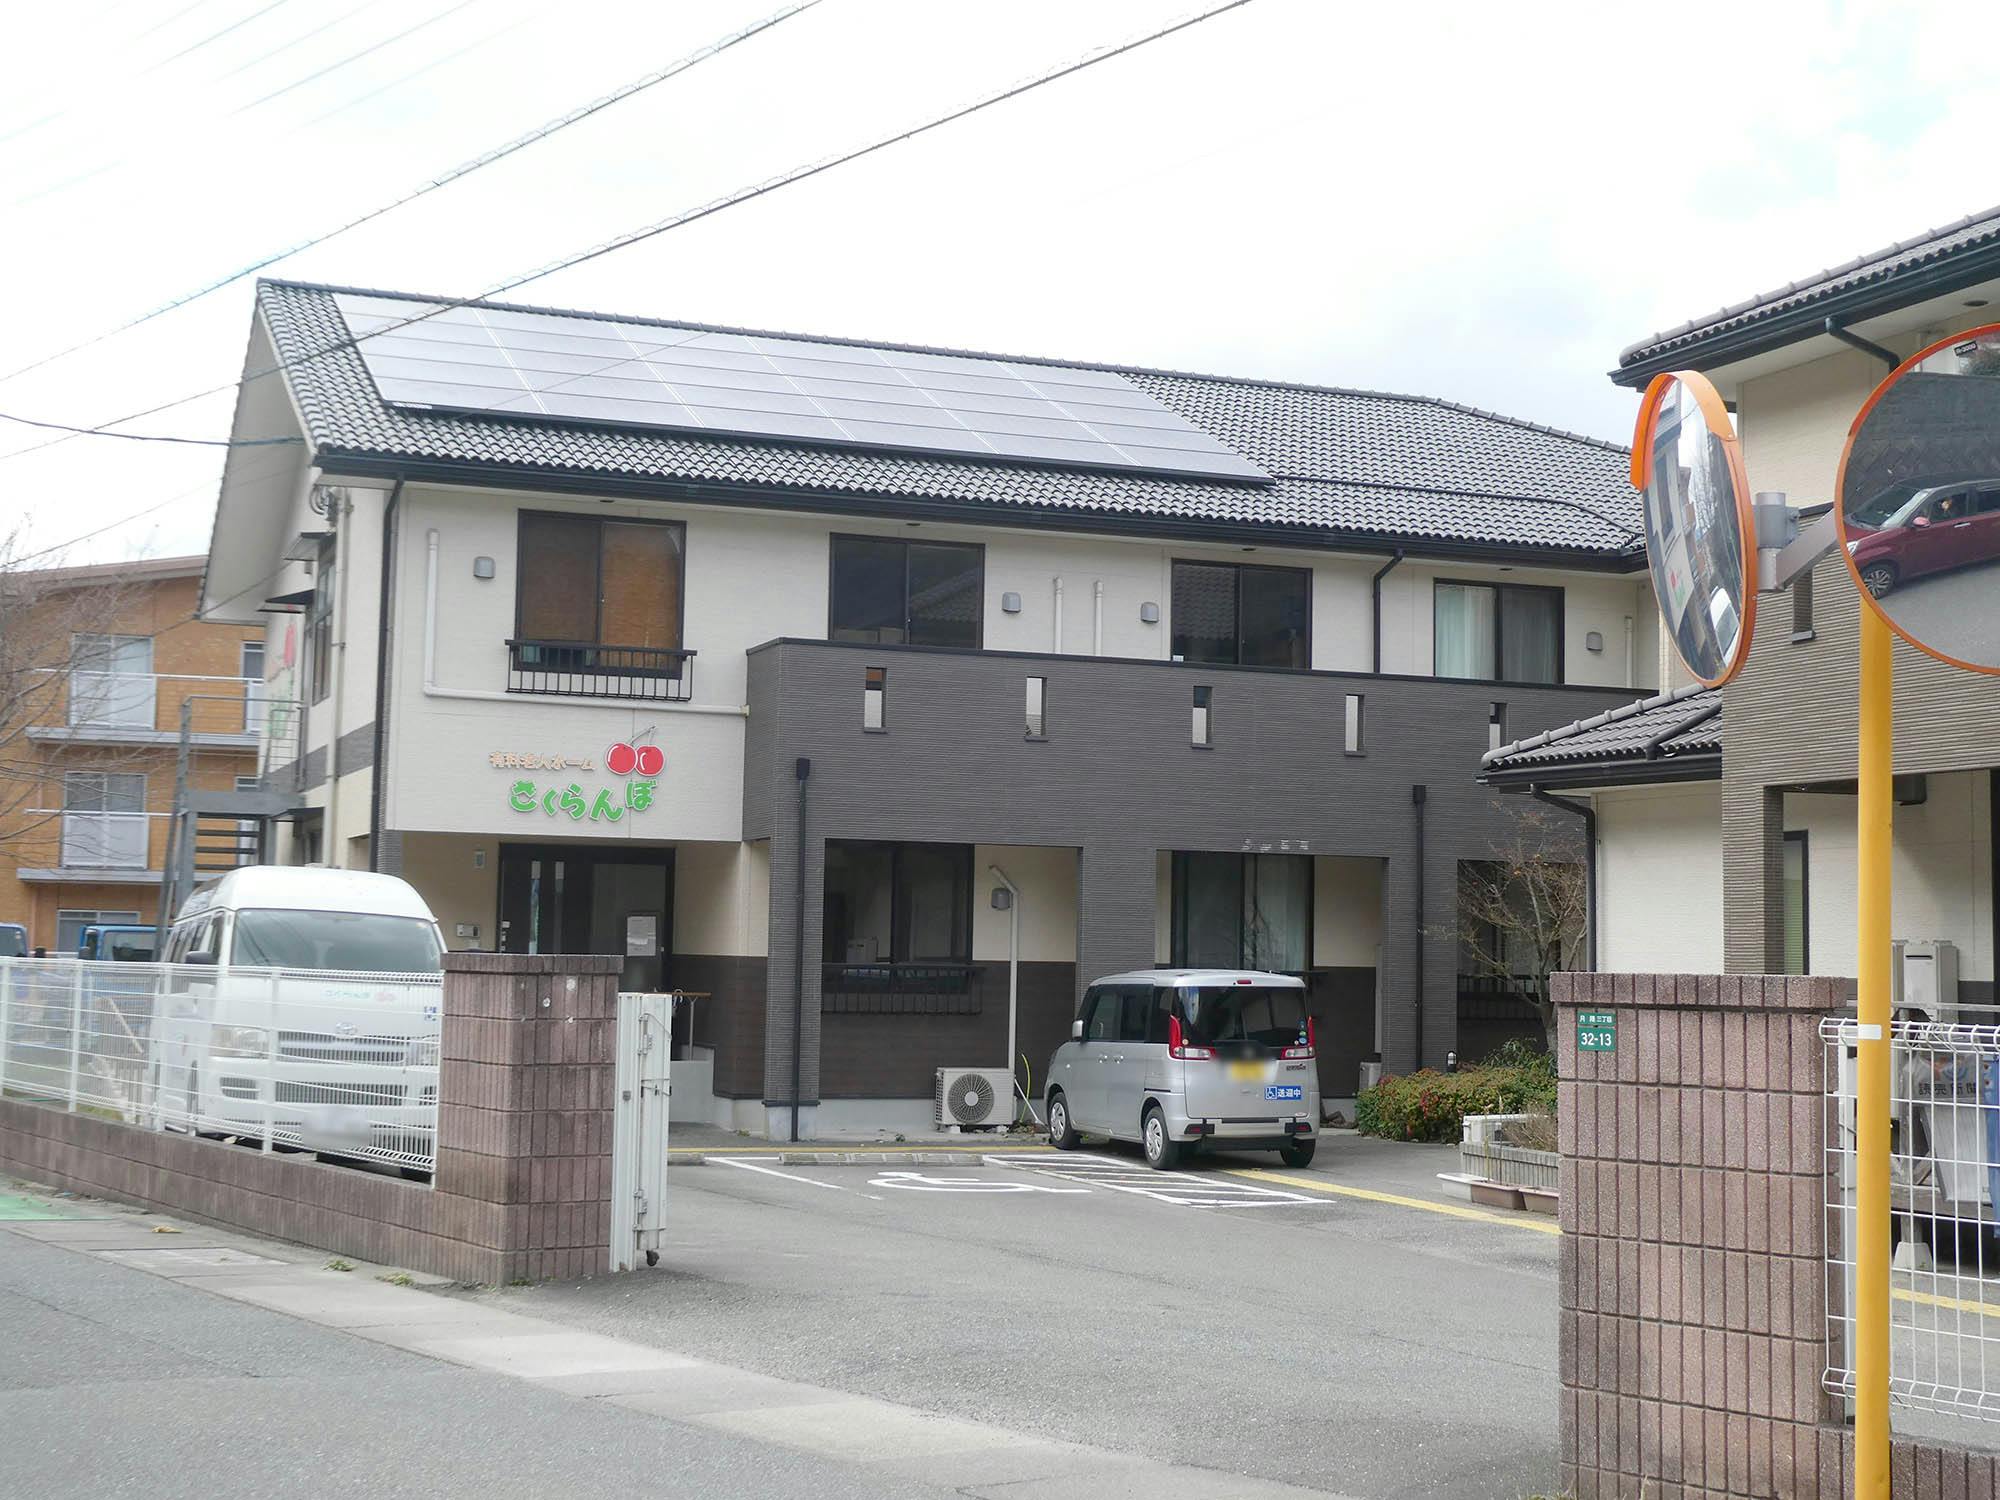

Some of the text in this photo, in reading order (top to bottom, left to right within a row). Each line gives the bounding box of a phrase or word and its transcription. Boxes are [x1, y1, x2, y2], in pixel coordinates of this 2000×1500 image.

[489, 751, 595, 771] 有料老人ホーム
[509, 778, 658, 822] さくらんぼ
[1580, 1032, 1612, 1046] 32-13
[1277, 1088, 1301, 1098] 送迎中
